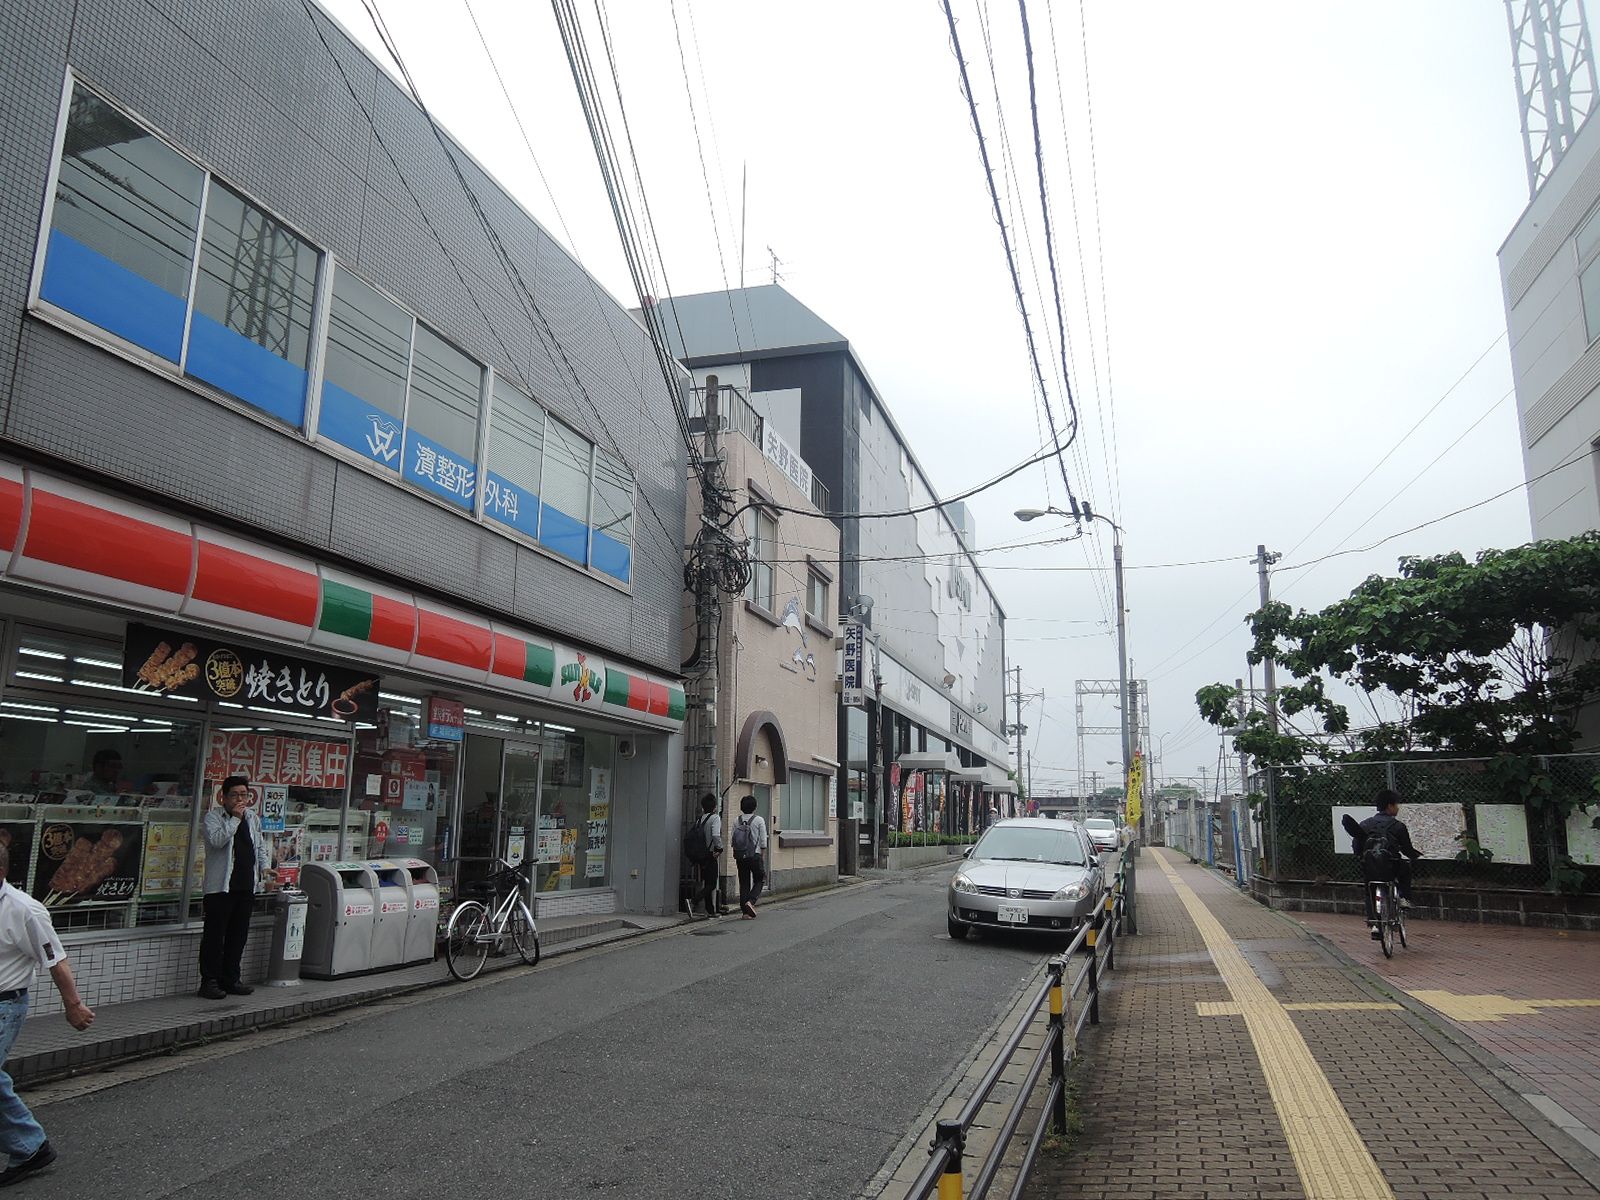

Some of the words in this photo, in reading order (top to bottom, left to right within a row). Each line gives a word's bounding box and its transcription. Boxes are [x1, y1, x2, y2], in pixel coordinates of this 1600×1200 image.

[767, 431, 808, 493] 矢野医院
[845, 626, 856, 689] 矢野医院
[245, 659, 330, 709] 焼きとり
[230, 737, 347, 787] 会員募集中
[265, 801, 283, 815] Edy
